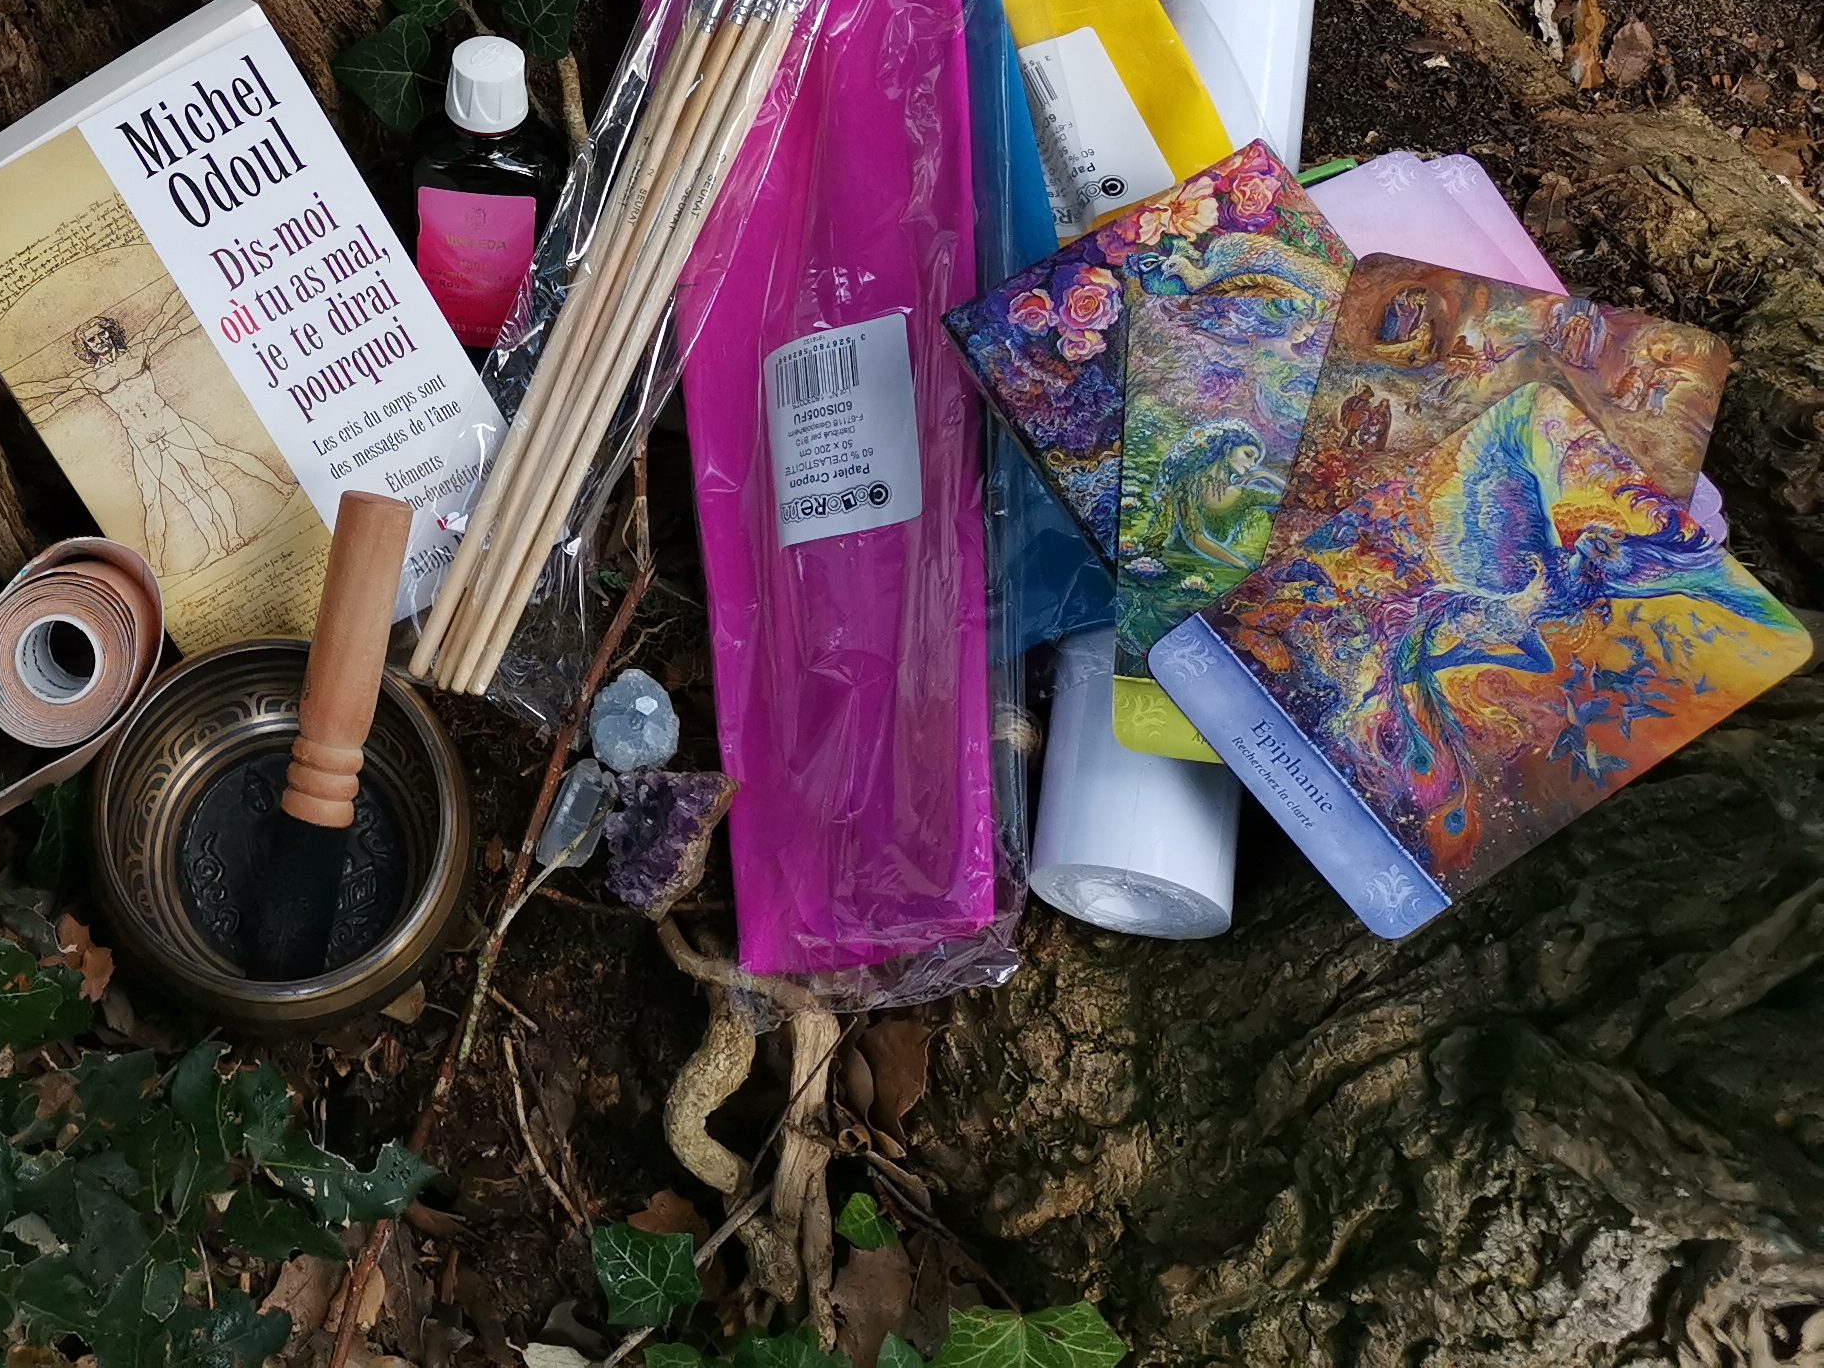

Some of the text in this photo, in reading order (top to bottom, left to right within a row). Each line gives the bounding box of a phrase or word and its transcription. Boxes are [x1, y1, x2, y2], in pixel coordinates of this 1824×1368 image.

[115, 55, 282, 180] Michel
[168, 117, 308, 228] Odoul
[627, 189, 649, 227] SEURAT
[691, 174, 716, 219] SEURAT
[209, 191, 341, 292] Dis-moi
[220, 299, 262, 344] où
[254, 284, 293, 322] tu
[290, 264, 327, 304] as
[321, 224, 391, 285] mal,
[251, 342, 289, 389] je
[289, 322, 324, 357] te
[324, 270, 401, 338] dirai
[287, 315, 418, 424] pourquoi
[312, 373, 447, 457] Les cris du corps sont
[329, 399, 462, 482] des messages de l'âme
[793, 400, 853, 425] 6DIS005FU
[799, 449, 813, 457] cm
[816, 443, 832, 455] 200
[843, 439, 854, 449] 50
[384, 453, 445, 494] Éléments
[785, 447, 874, 476] 60 % D'ELASTICITE
[789, 462, 870, 488] Papier Crepon
[1232, 736, 1313, 830] Recherchez la clarté
[1250, 719, 1334, 814] Épiphanie
